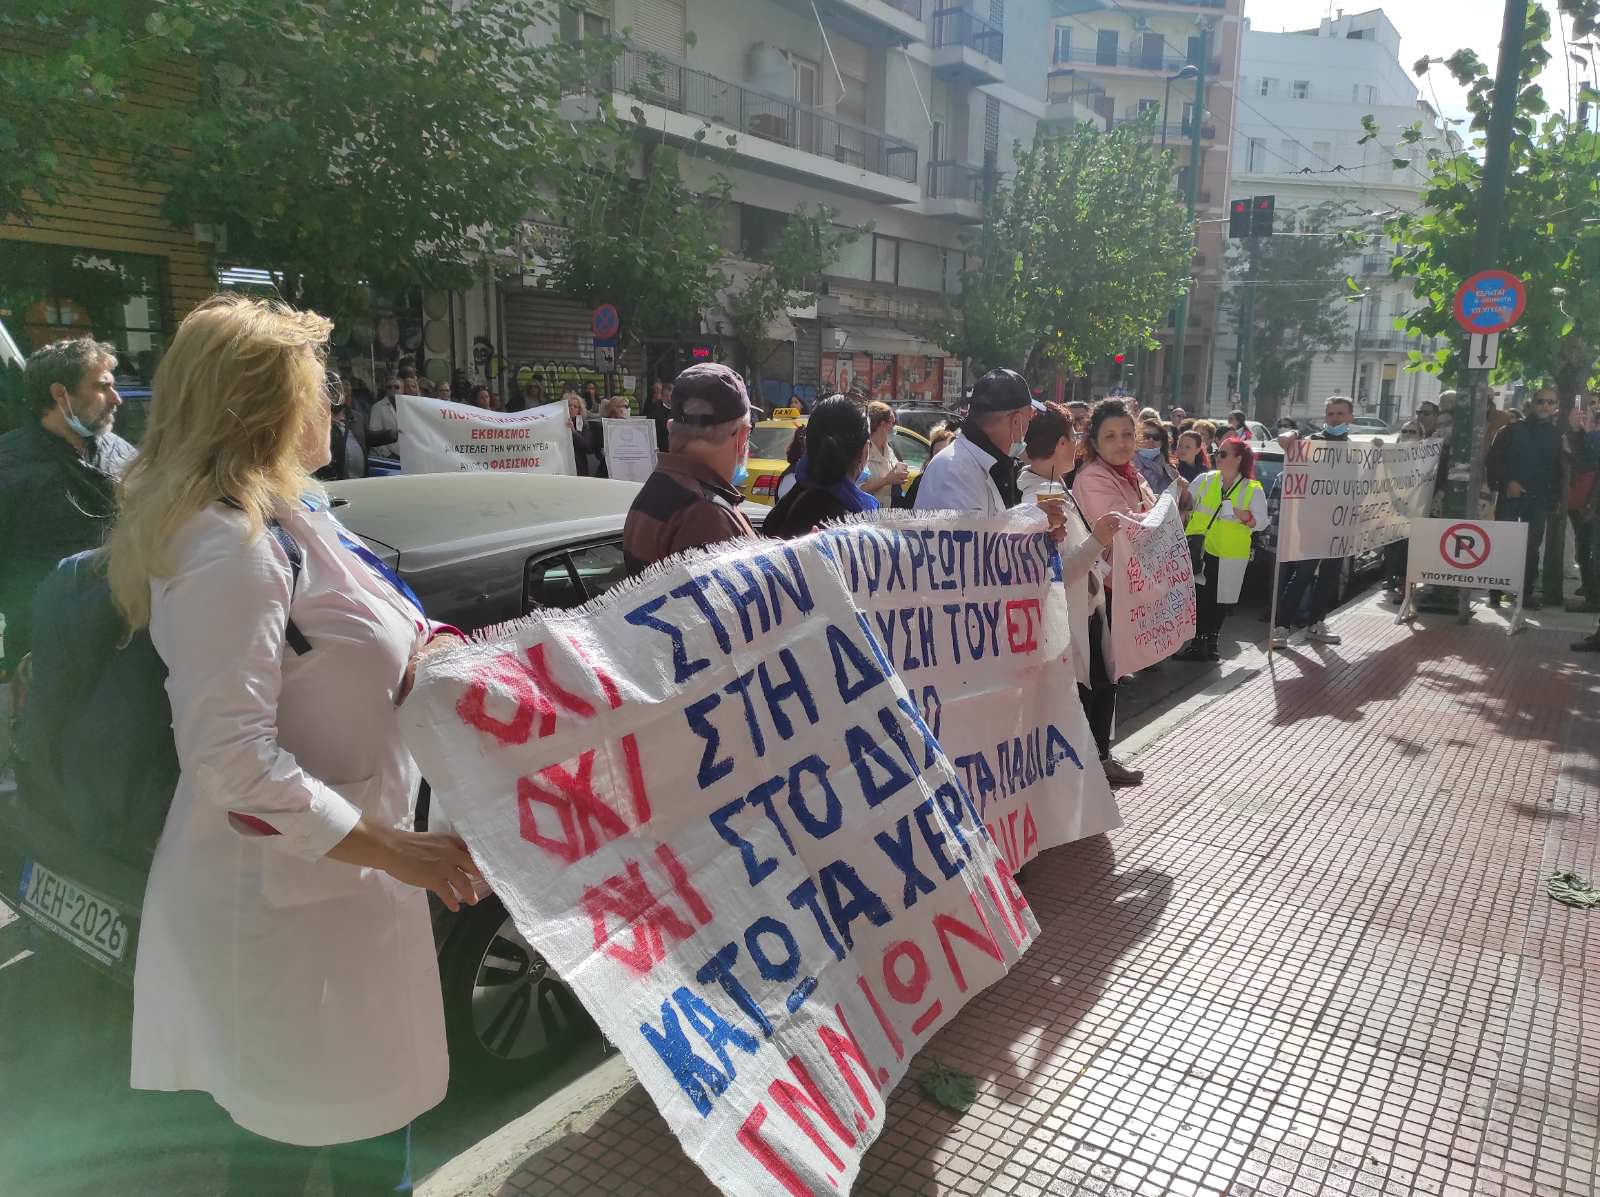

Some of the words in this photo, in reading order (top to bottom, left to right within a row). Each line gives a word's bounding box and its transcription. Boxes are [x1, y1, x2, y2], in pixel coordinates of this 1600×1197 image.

[471, 428, 530, 440] ΕΚΒΙΑΣΜΟΣ
[489, 444, 505, 453] ΤΗΝ
[1286, 441, 1311, 463] ΟΧΙ
[1313, 447, 1342, 469] στην
[490, 457, 541, 470] ΦΑΣΙΣΜΟΣ
[1284, 473, 1309, 496] ΟΧΙ
[1311, 479, 1340, 496] στον
[1421, 571, 1474, 583] ΥΠΟΥΡΓΕΙΟ
[1477, 576, 1512, 586] ΥΓΕΙΑΣ
[456, 636, 623, 745] ΟΧΙ
[624, 546, 815, 684] ΣΤΗΝ
[517, 733, 652, 864] ΟΧΙ
[684, 648, 820, 790] ΣΤΗ
[943, 600, 1001, 664] ΤΟΥ
[583, 842, 713, 975] ΟΧΙ
[709, 754, 843, 887] ΣΤΟ
[639, 916, 818, 1119] ΚΑΤΩ
[787, 859, 892, 962] ΤΑ
[954, 751, 997, 822] ΤΑ
